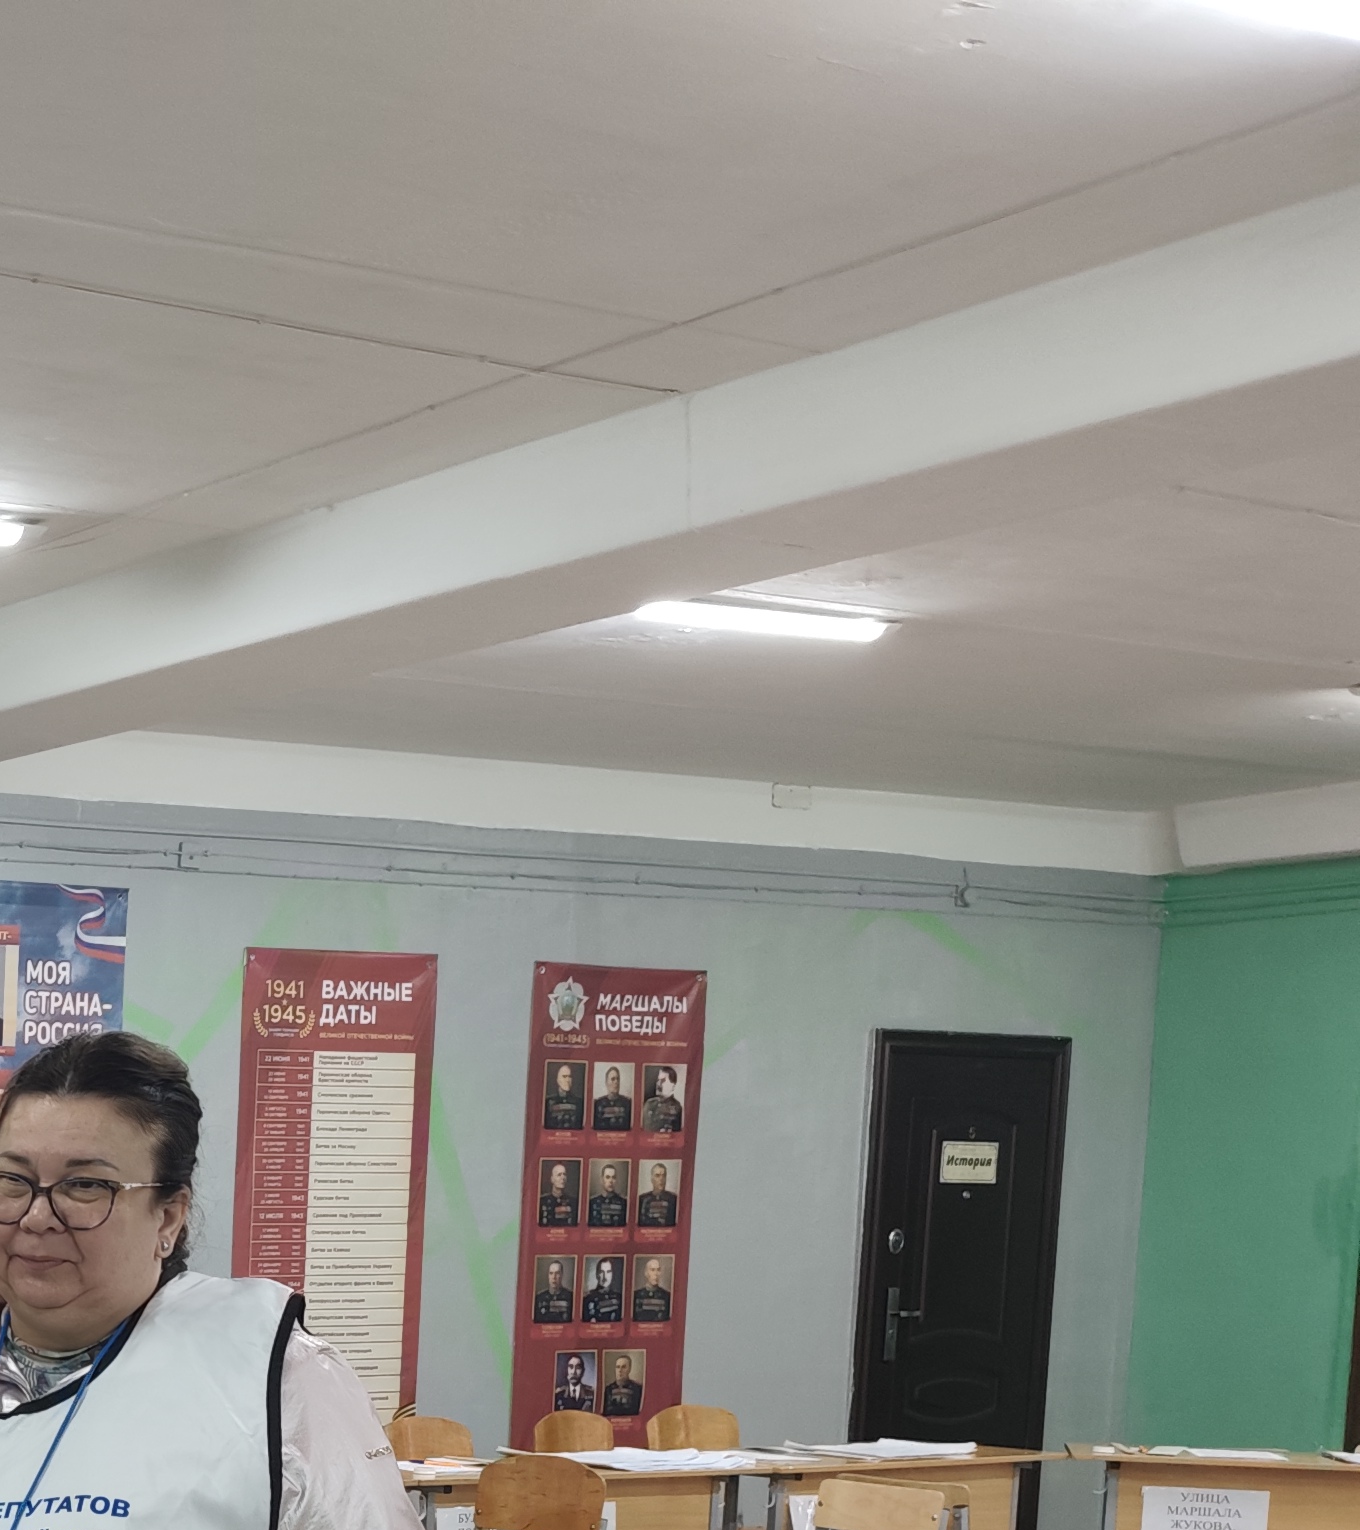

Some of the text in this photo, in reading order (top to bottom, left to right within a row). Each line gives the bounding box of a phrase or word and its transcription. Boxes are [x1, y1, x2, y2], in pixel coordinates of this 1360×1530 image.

[26, 960, 71, 985] МОЯ
[266, 979, 304, 998] 1941
[321, 979, 413, 1002] ВАЖНЫЕ
[25, 991, 113, 1016] СТРАНА-
[597, 993, 688, 1013] МАРШАЛЫ
[263, 1004, 306, 1024] 1945
[319, 1003, 377, 1027] ДАТЫ
[595, 1014, 667, 1036] ПОБЕДЫ
[946, 1155, 992, 1170] История
[1180, 1492, 1230, 1504] УЛИЦА
[1167, 1506, 1242, 1519] МАРШАЛА
